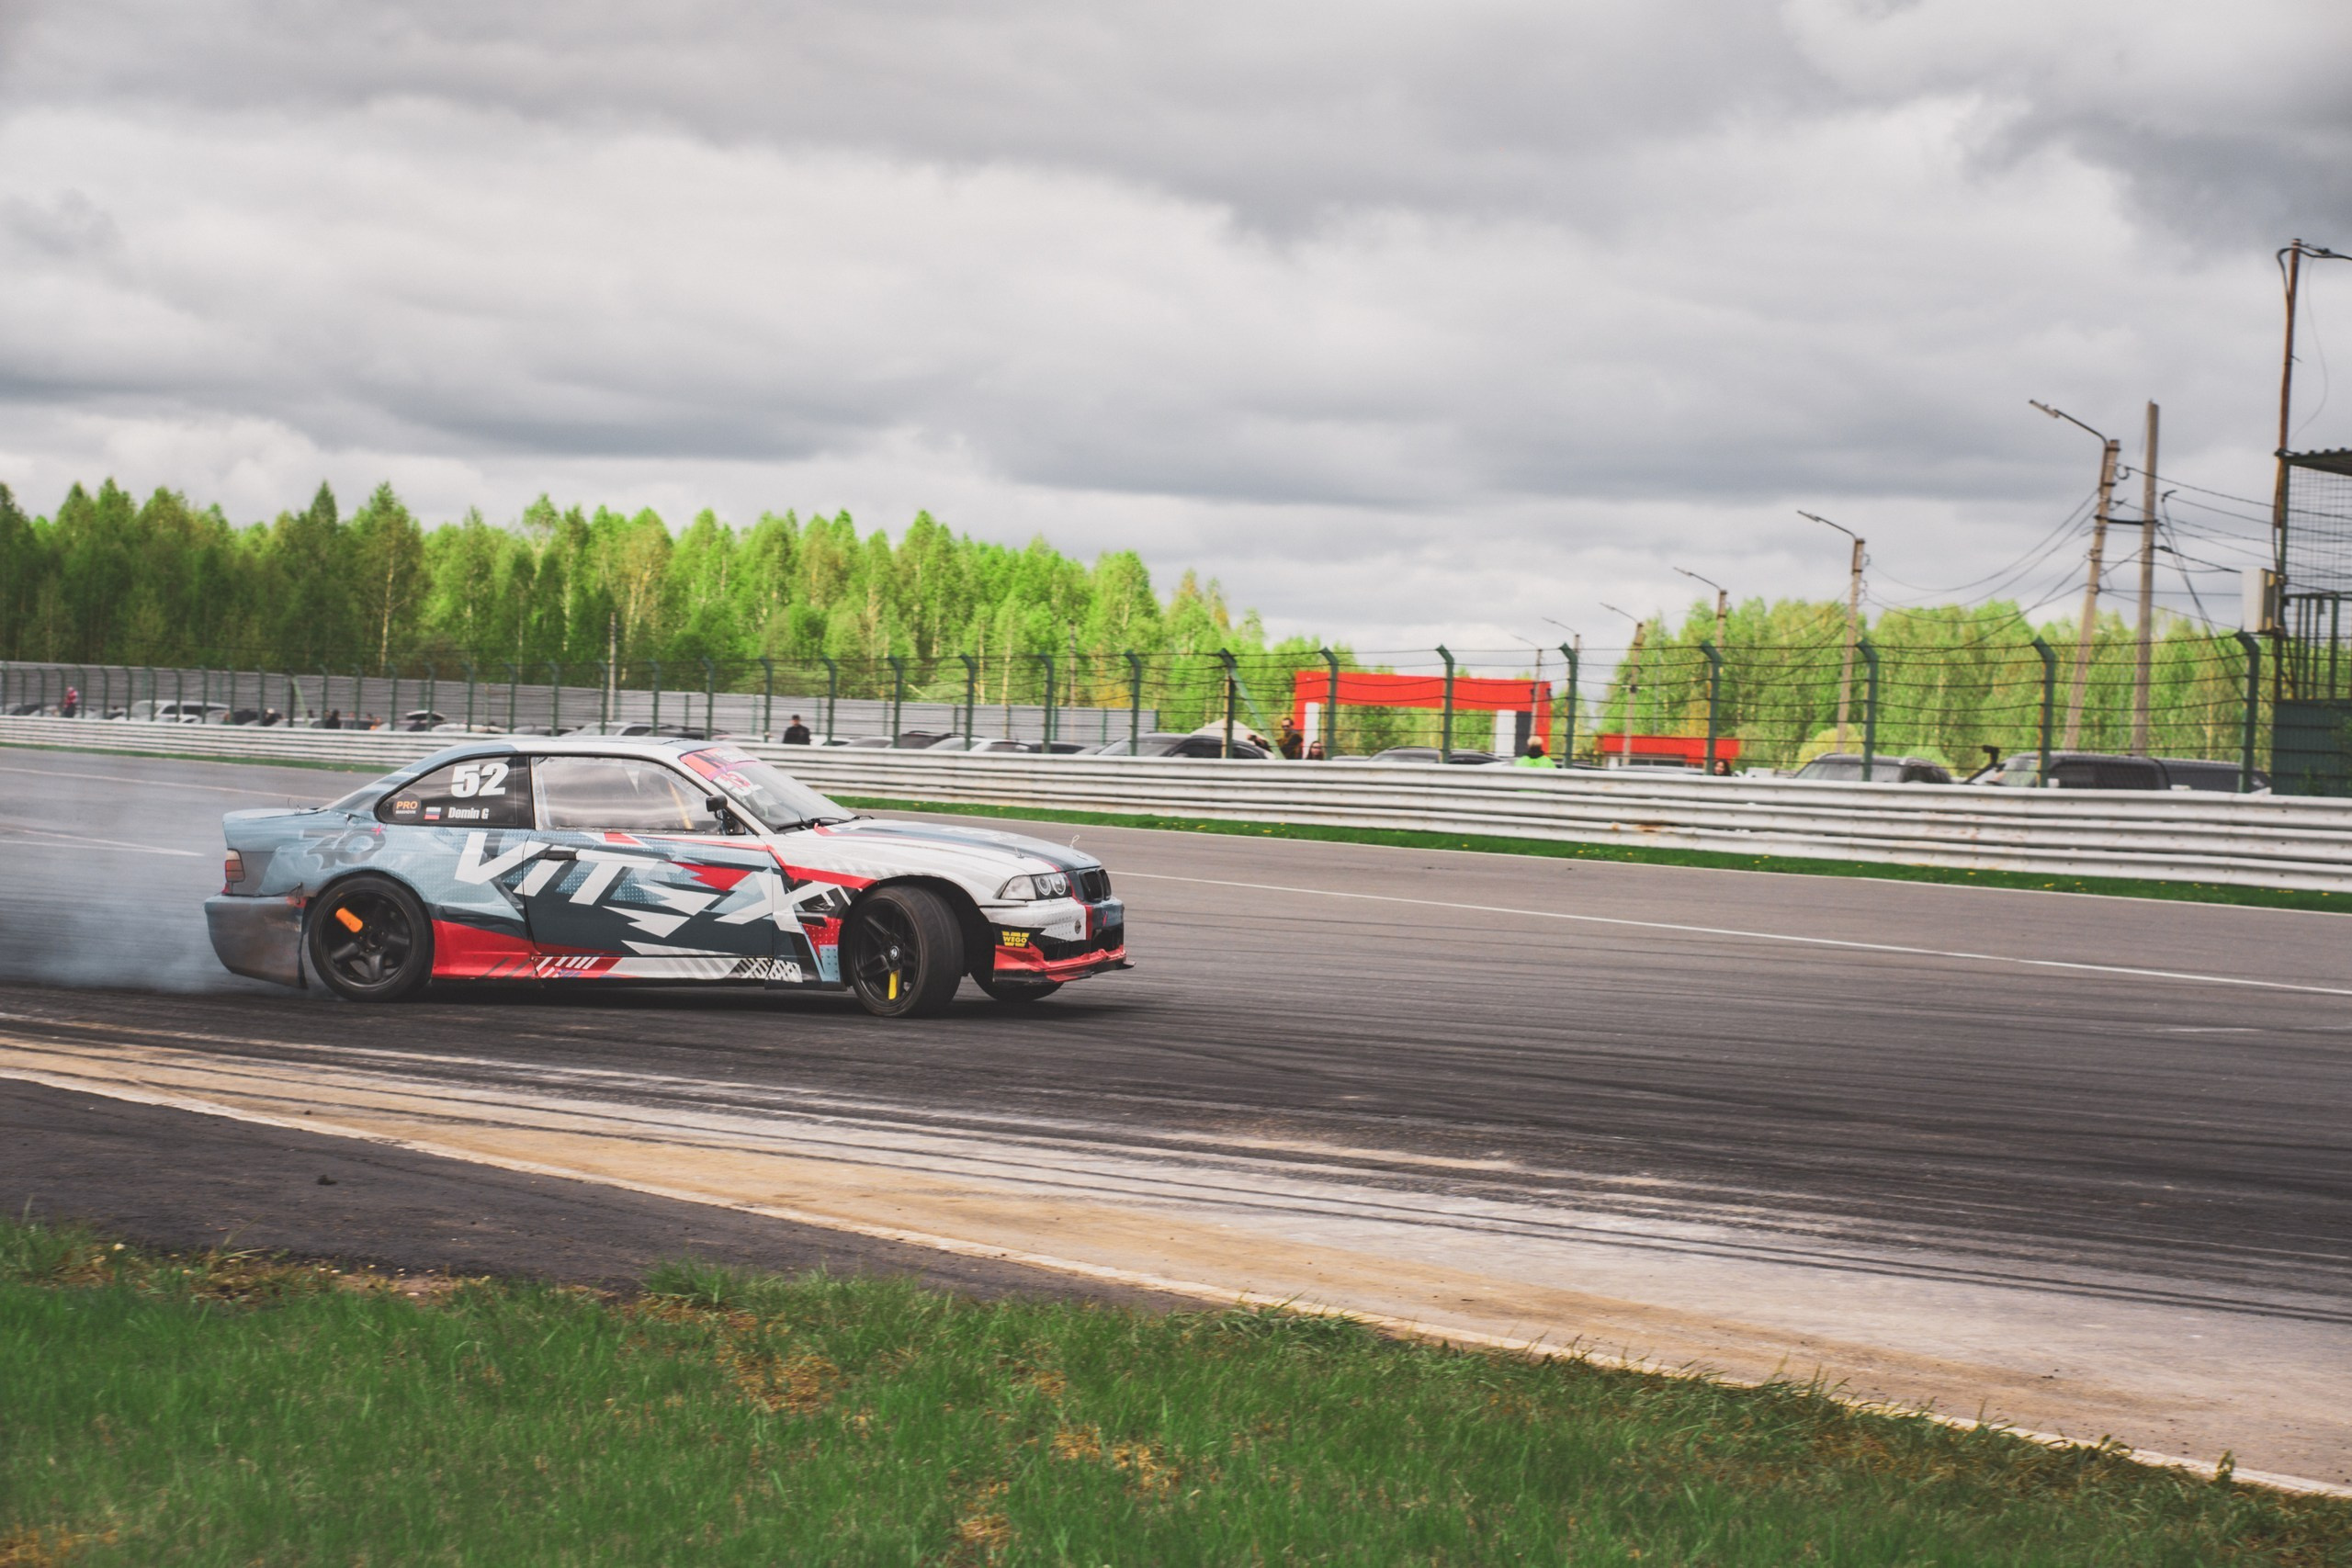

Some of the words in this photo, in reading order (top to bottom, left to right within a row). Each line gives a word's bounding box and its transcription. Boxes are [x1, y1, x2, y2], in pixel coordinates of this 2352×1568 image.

[451, 763, 510, 797] 52
[396, 801, 418, 809] PRO
[448, 807, 480, 819] Demin
[481, 807, 490, 819] G
